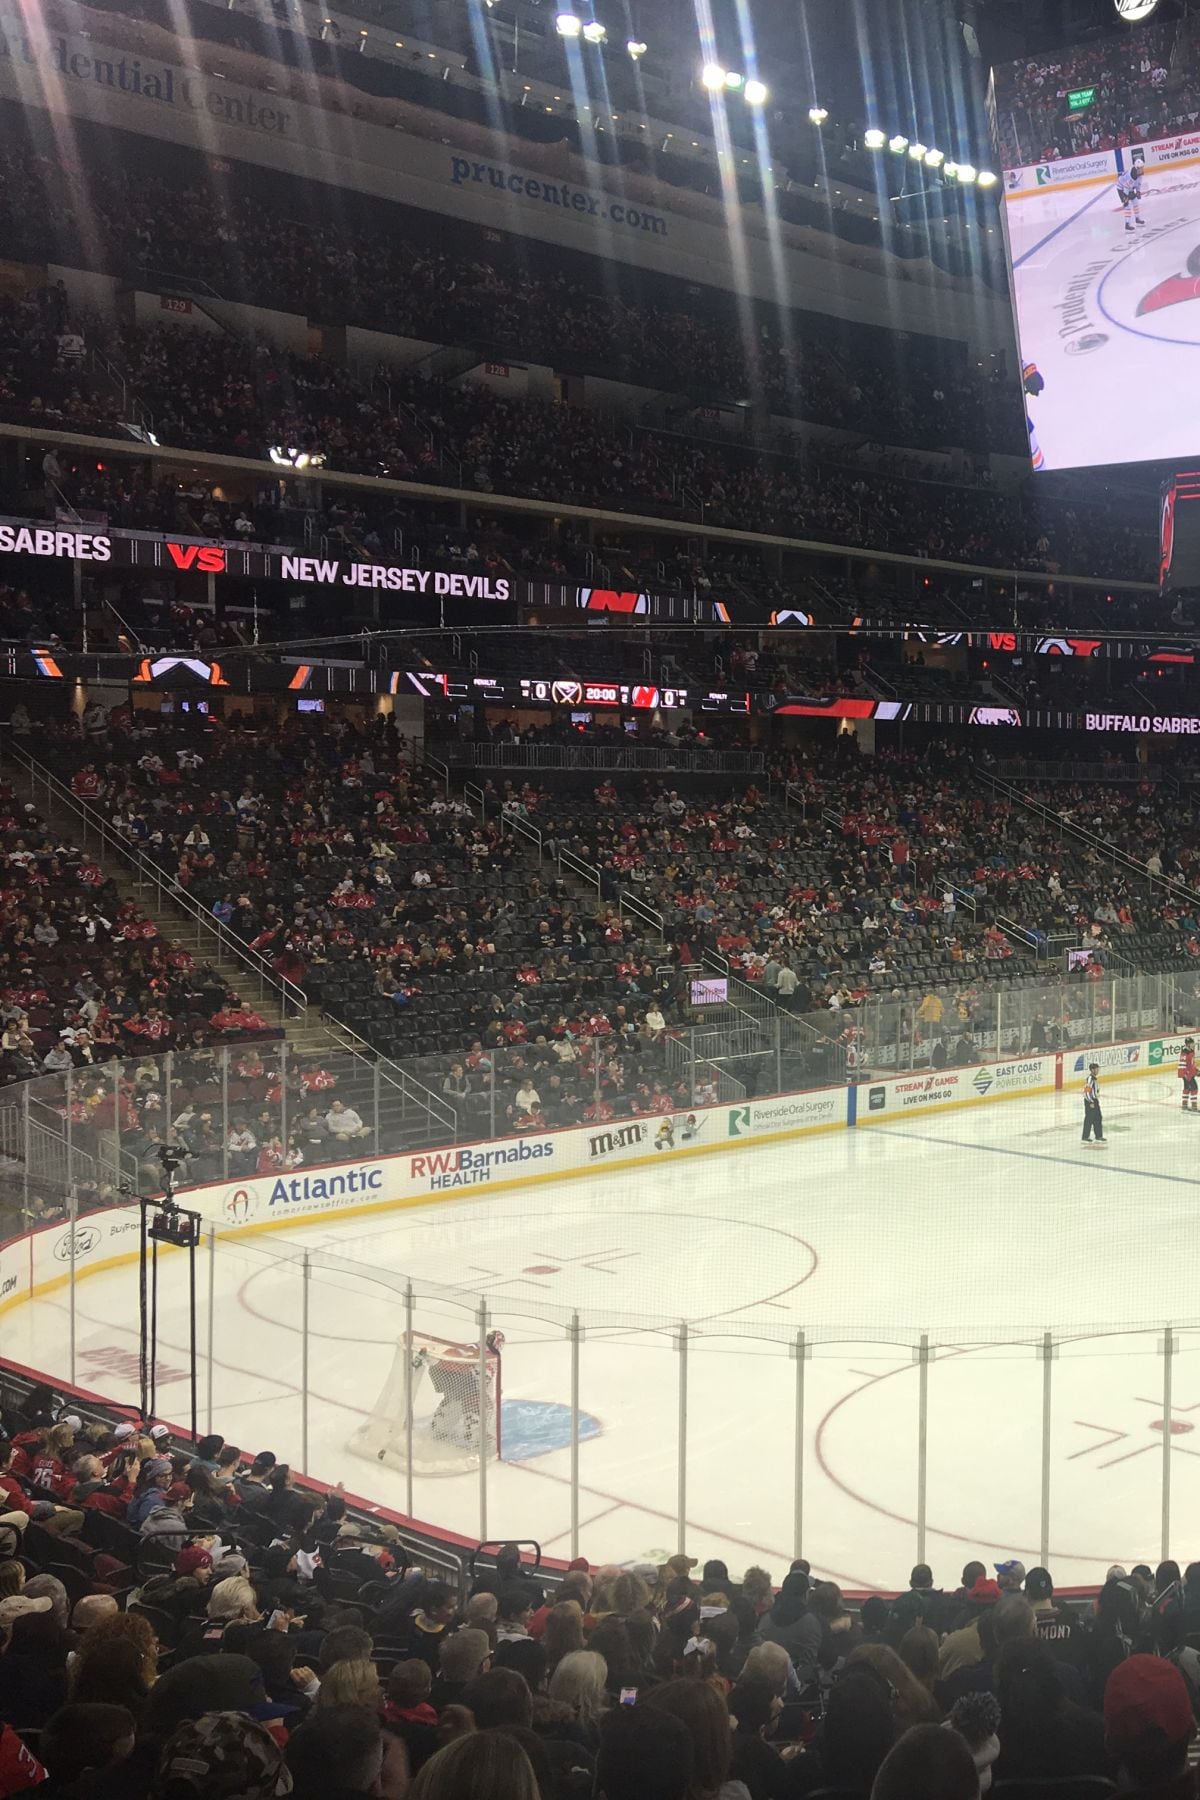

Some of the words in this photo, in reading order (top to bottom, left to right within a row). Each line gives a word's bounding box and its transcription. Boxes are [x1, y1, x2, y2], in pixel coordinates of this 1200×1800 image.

[181, 75, 290, 133] Center
[1151, 140, 1175, 153] STREAM
[451, 155, 668, 236] prucenter.com
[166, 299, 187, 312] 129
[0, 525, 111, 561] SABRES
[166, 542, 226, 572] VS
[281, 555, 339, 583] NEW
[342, 563, 430, 593] JERSEY
[434, 572, 510, 601] DEVILS
[990, 631, 1017, 651] VS
[535, 683, 547, 699] 0
[586, 687, 616, 702] 20:00
[664, 692, 675, 706] 0
[1086, 713, 1150, 732] BUFFALO
[996, 1066, 1016, 1077] EAST
[1017, 1062, 1042, 1073] COAST
[895, 1081, 923, 1093] STREAM
[934, 1075, 959, 1087] GAMES
[996, 1076, 1022, 1089] POWER
[1029, 1074, 1042, 1083] GAS
[903, 1095, 918, 1105] LIVE
[918, 1094, 928, 1102] ON
[929, 1091, 941, 1101] MSG
[943, 1090, 952, 1099] GO
[754, 1105, 788, 1120] Riverside
[788, 1102, 805, 1115] Oral
[805, 1100, 835, 1113] Surgery
[268, 1163, 382, 1207] Atlantic
[430, 1168, 491, 1190] HEALTH
[61, 1230, 95, 1259] Ford
